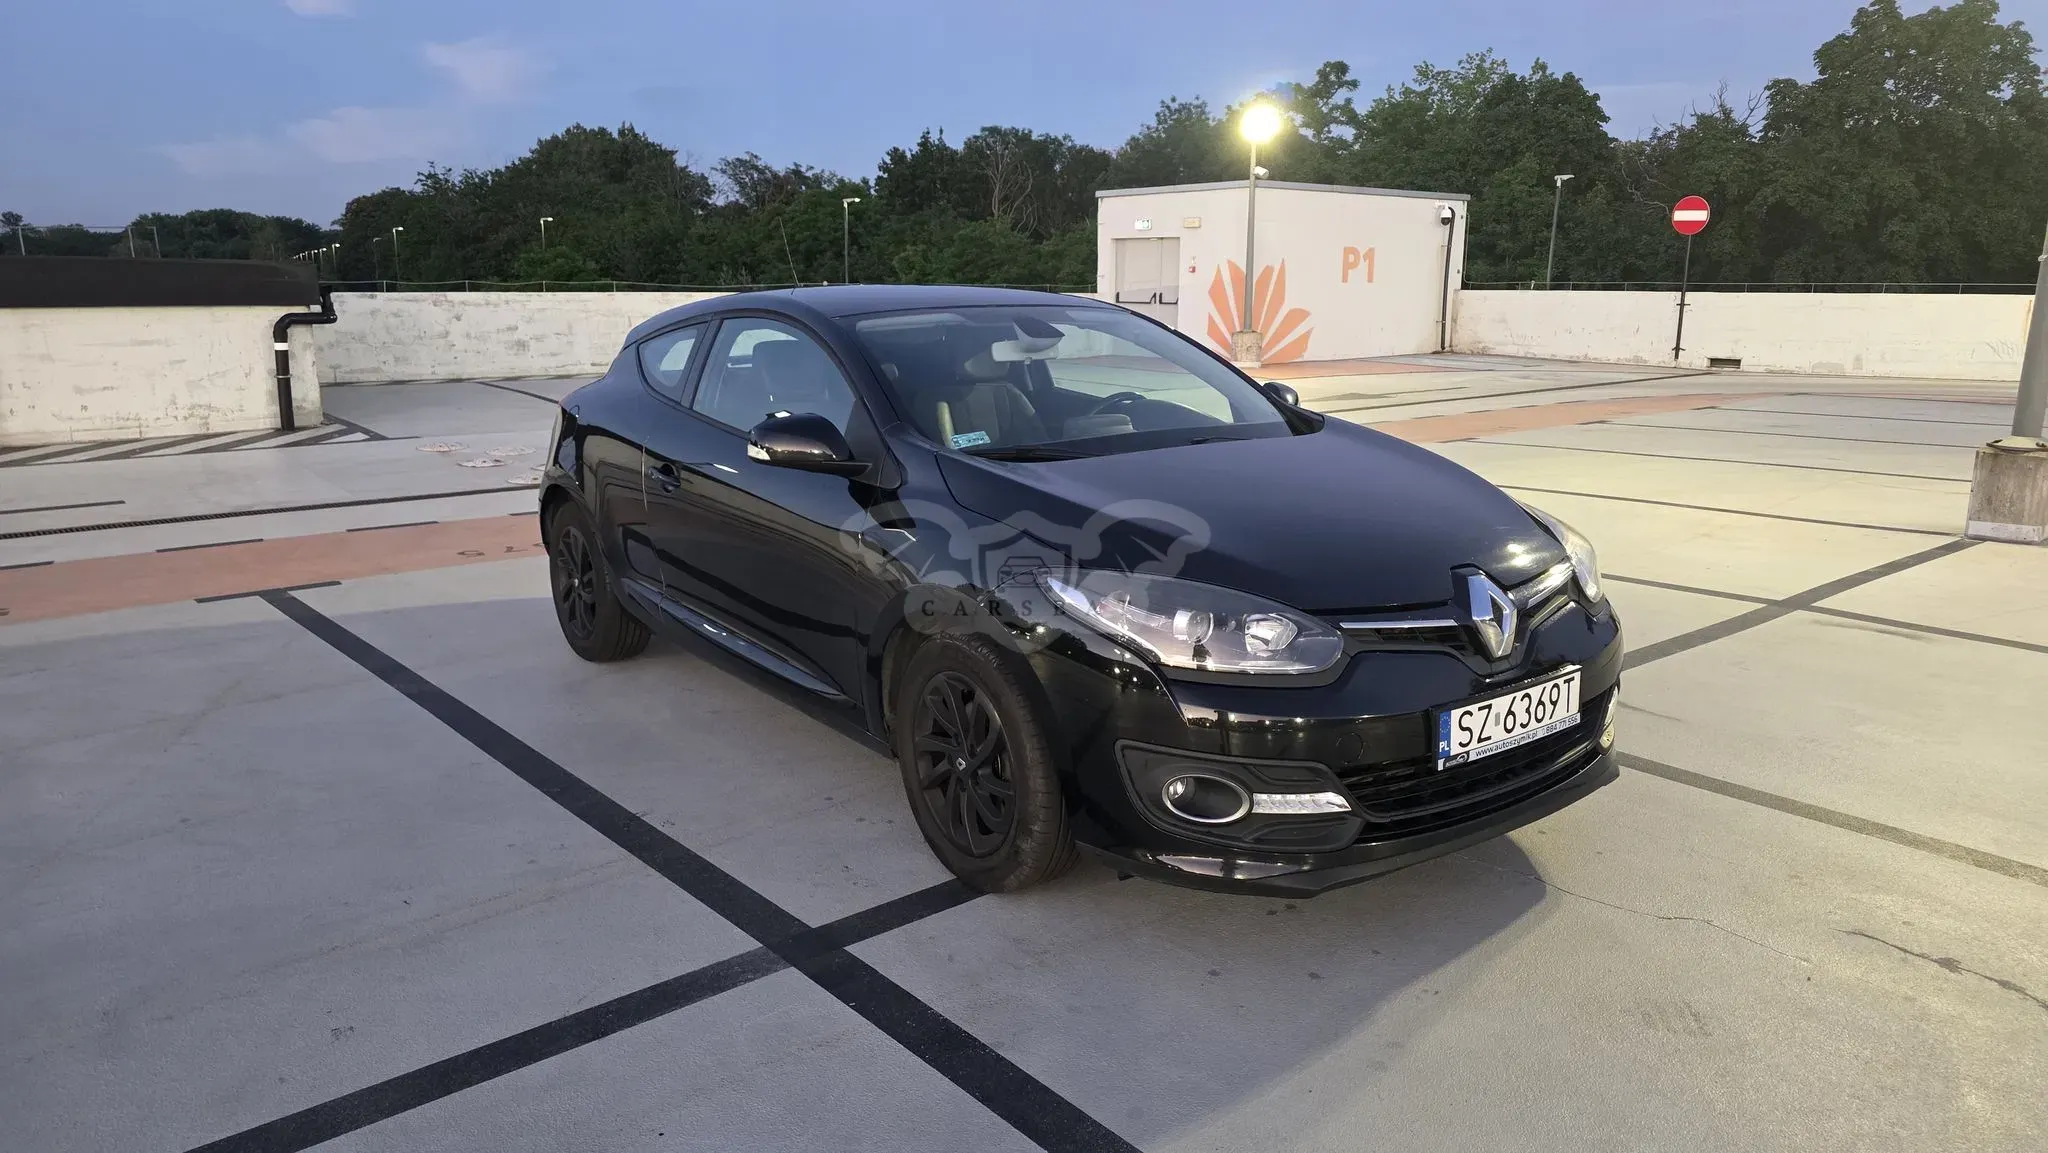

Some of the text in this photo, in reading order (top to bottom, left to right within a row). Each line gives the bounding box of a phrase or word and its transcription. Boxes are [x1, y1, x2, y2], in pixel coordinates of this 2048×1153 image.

[1342, 246, 1376, 283] P1
[1458, 676, 1575, 748] SZ 6369T
[1439, 740, 1450, 753] PL
